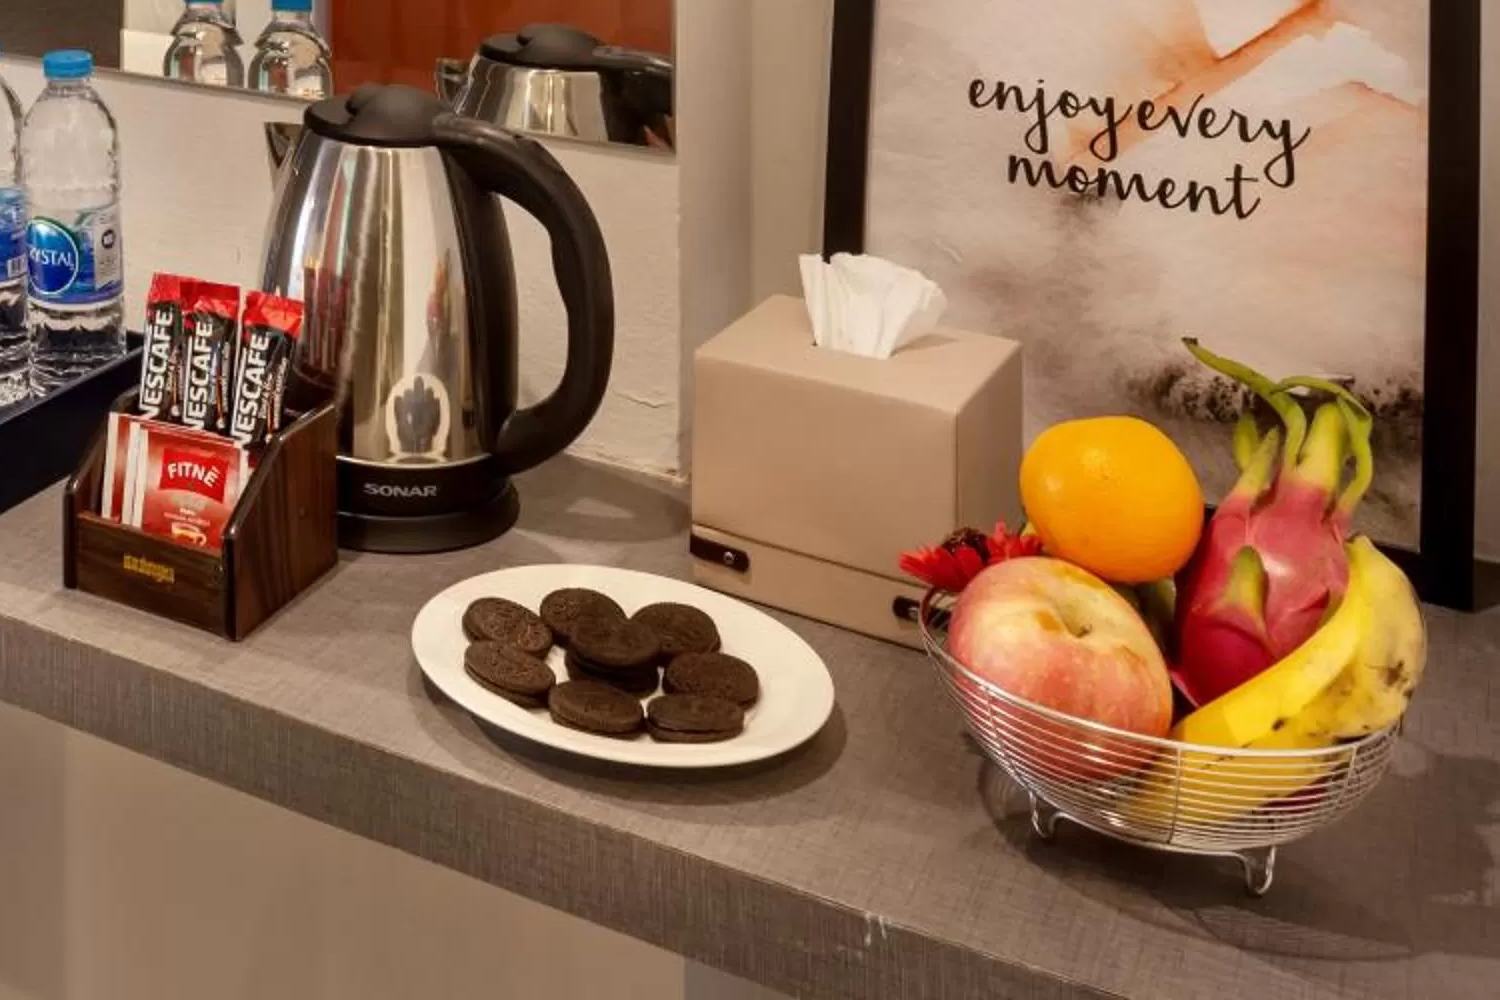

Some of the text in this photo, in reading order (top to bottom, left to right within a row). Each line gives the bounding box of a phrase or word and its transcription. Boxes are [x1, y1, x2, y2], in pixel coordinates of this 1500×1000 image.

[968, 78, 1311, 187] enjoy every
[1007, 153, 1261, 220] moment
[363, 483, 438, 498] SONAR
